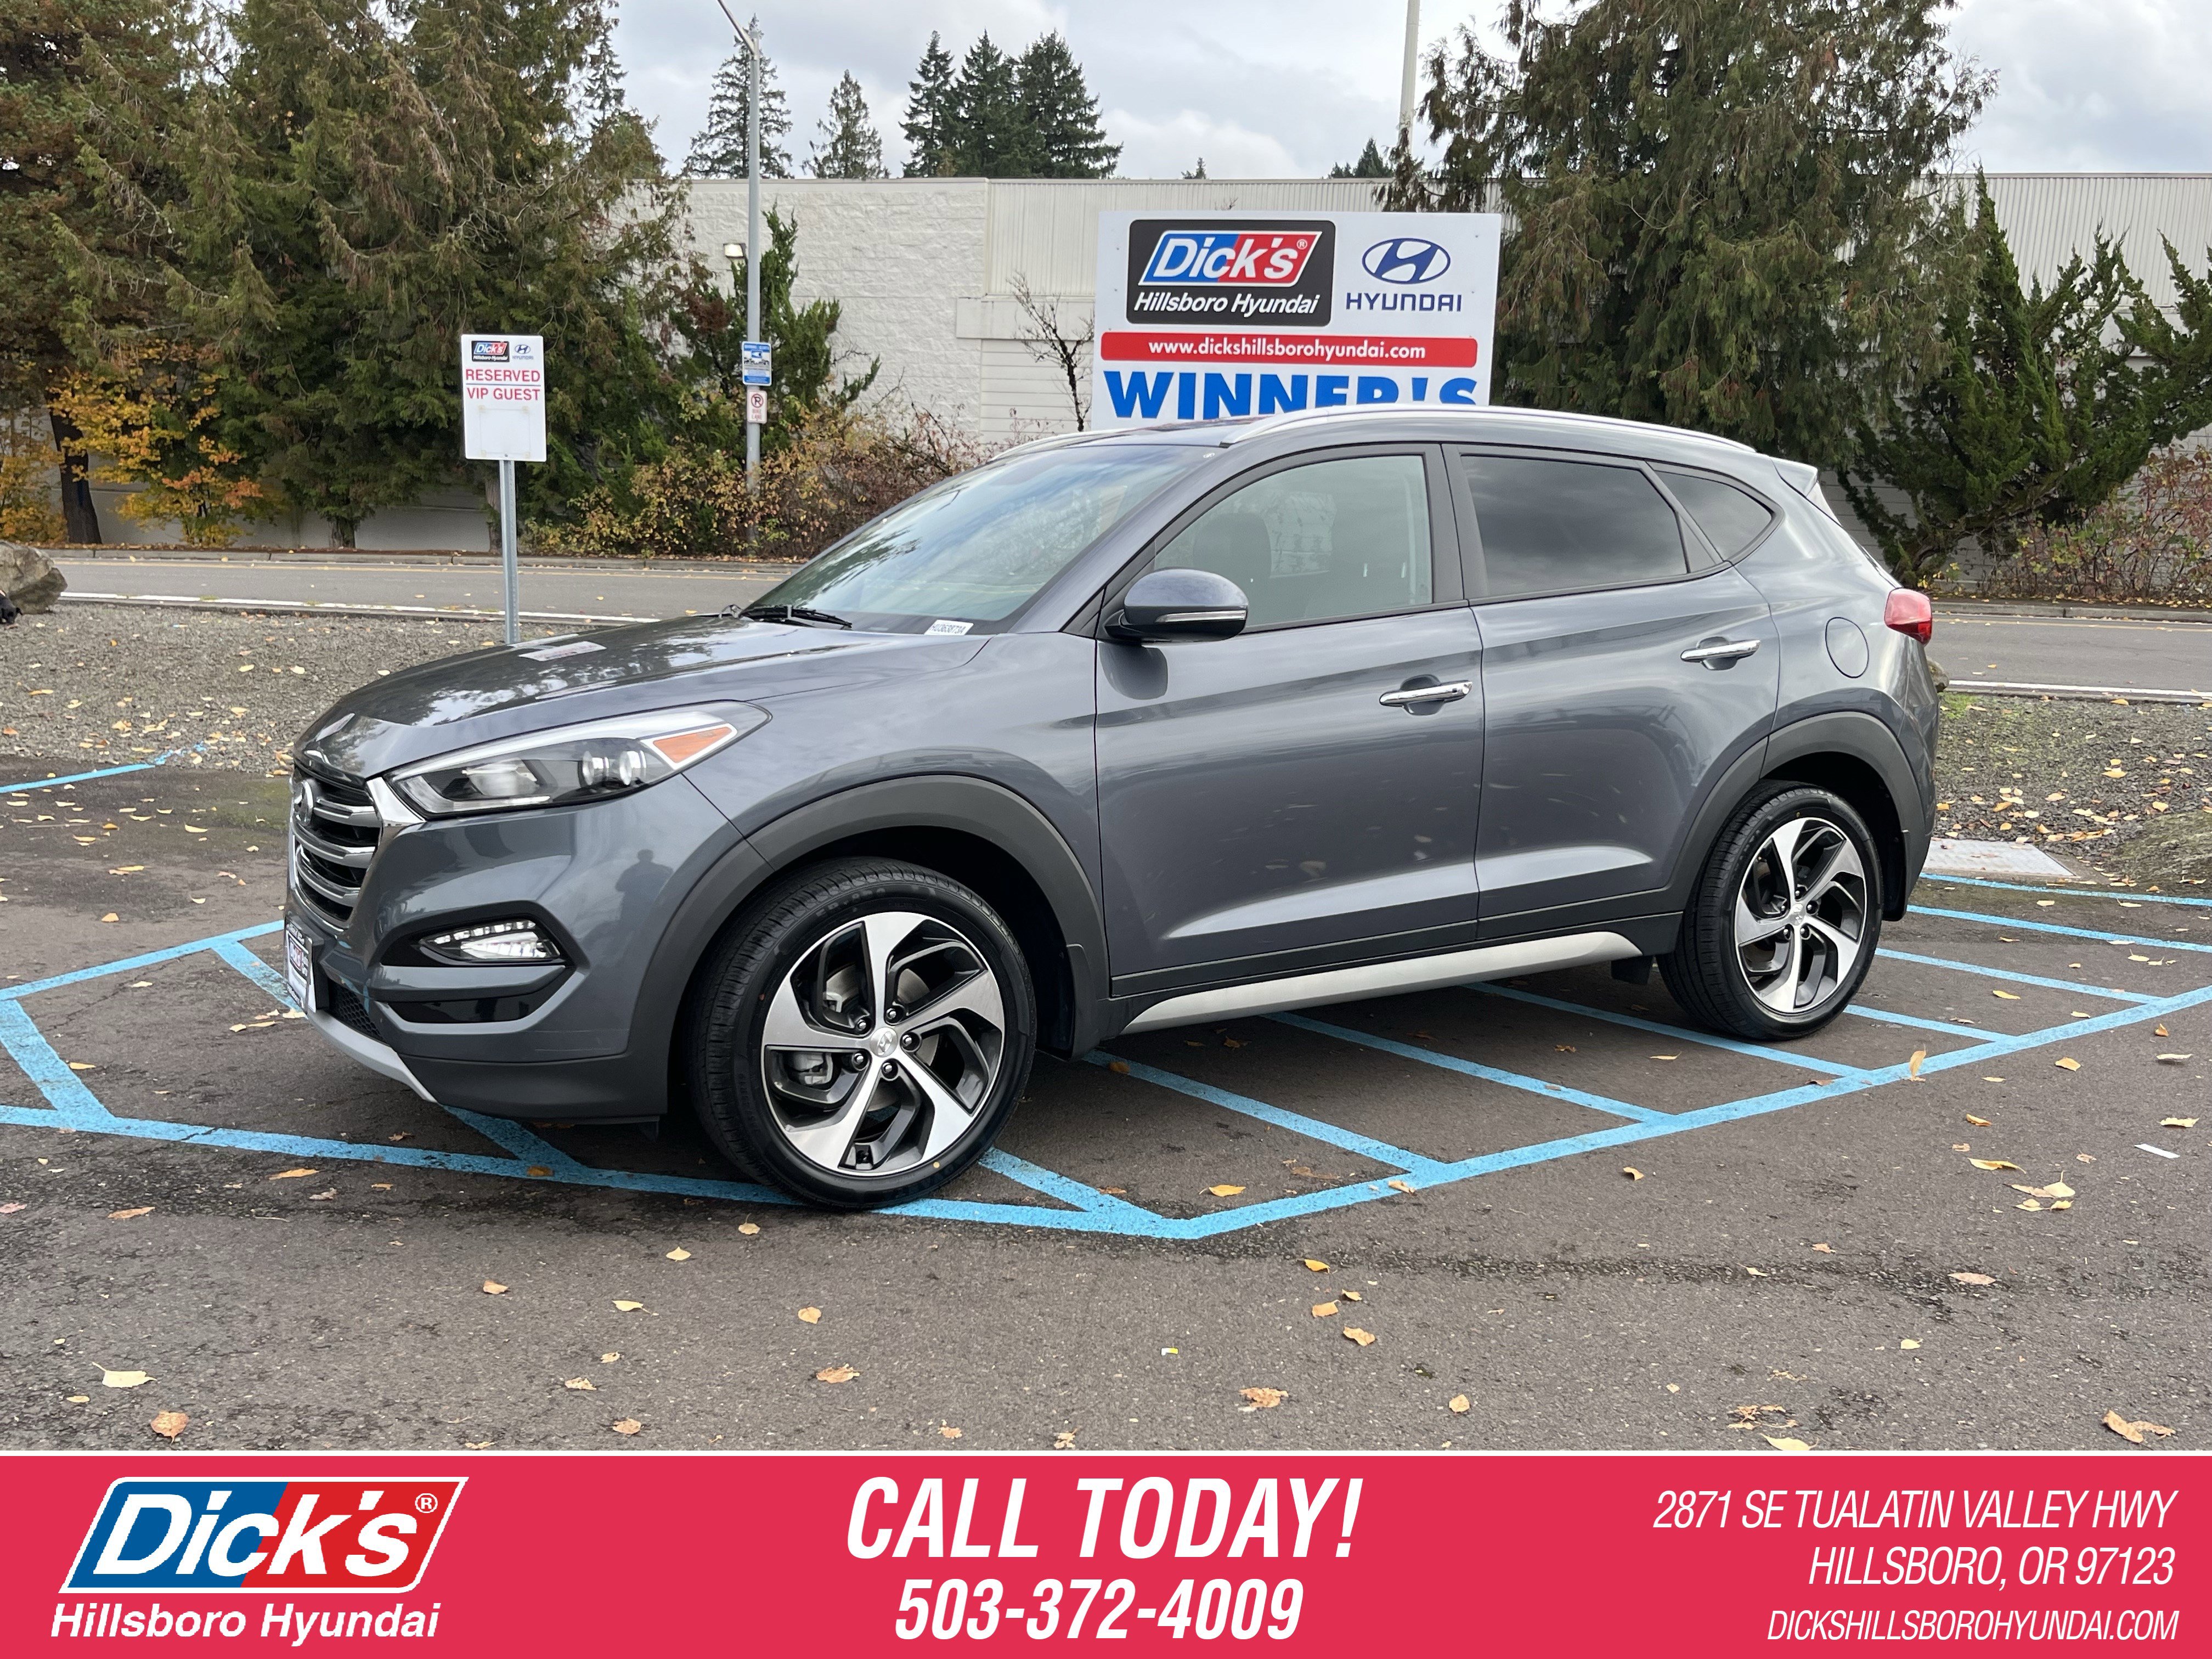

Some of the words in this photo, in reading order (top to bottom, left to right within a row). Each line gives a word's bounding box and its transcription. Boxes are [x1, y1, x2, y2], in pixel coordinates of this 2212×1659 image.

[1134, 291, 1228, 312] Hillsboro
[1231, 293, 1321, 318] Hyundai
[1346, 292, 1462, 312] HYUNDAI
[1148, 337, 1426, 362] www.dickshillsborohyundai.com
[466, 369, 540, 382] RESERVED
[467, 387, 488, 399] VIP
[493, 388, 540, 400] GUEST
